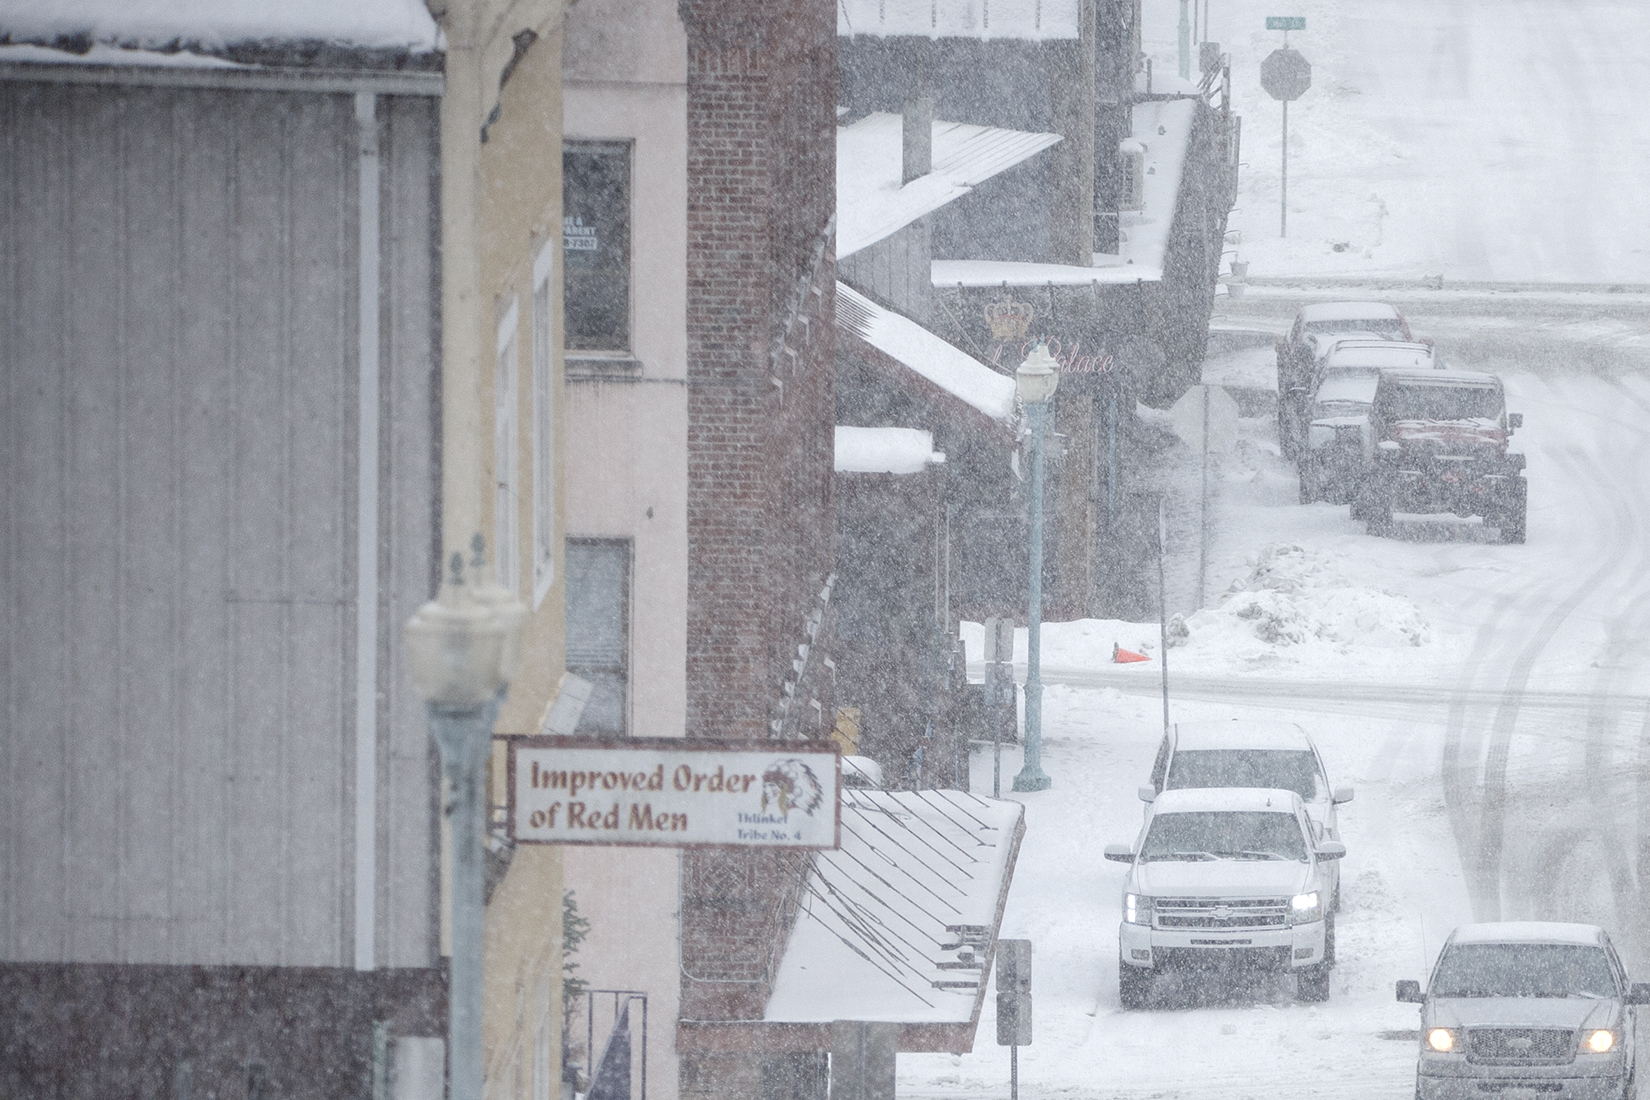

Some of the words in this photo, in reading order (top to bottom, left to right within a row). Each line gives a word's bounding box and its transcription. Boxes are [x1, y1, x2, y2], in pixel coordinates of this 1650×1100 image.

[531, 761, 664, 797] Improved
[673, 763, 756, 793] Order
[529, 801, 562, 829] of
[567, 801, 620, 830] Red
[628, 803, 688, 831] Men
[737, 829, 768, 840] Tribe
[771, 830, 791, 840] No.
[794, 831, 802, 841] 4
